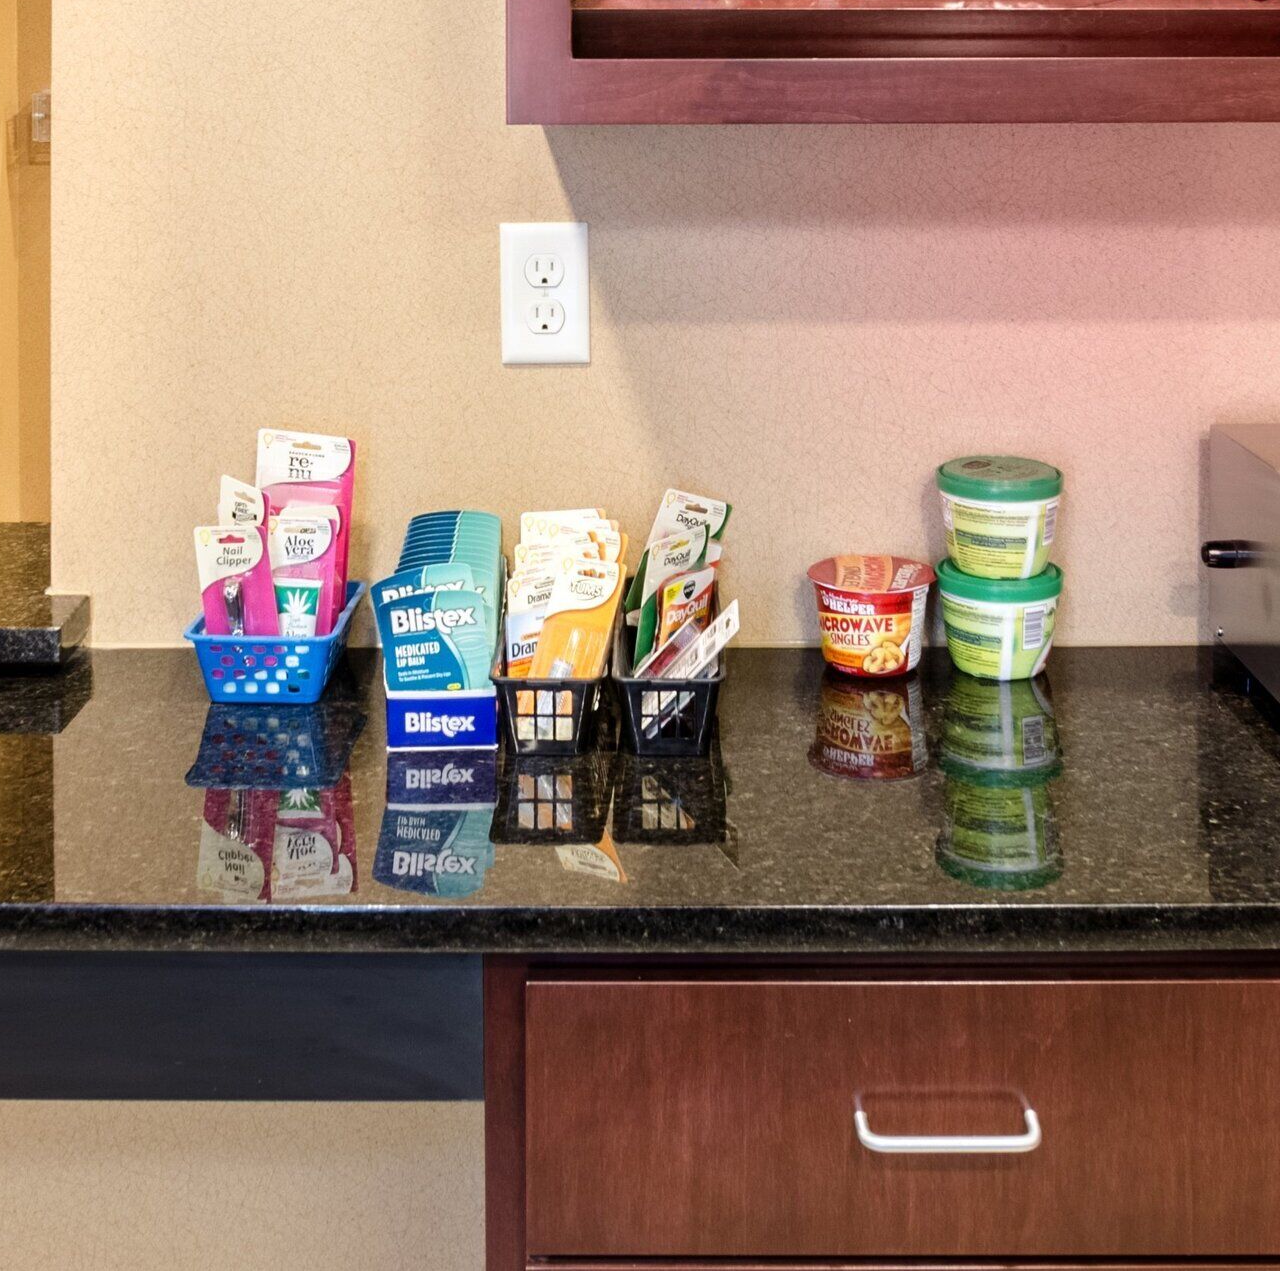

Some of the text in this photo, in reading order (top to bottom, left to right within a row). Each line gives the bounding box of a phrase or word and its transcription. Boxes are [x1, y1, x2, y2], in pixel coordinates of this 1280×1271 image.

[284, 536, 315, 547] Aloe
[222, 546, 243, 556] Nail
[284, 545, 314, 556] Vera
[216, 556, 252, 567] Clipper
[829, 600, 875, 616] HELPER
[390, 607, 477, 635] Blistex
[830, 633, 871, 647] SINGLES
[395, 641, 441, 657] MEDICATED
[396, 655, 425, 668] LIP BALM
[405, 712, 476, 738] Blistex
